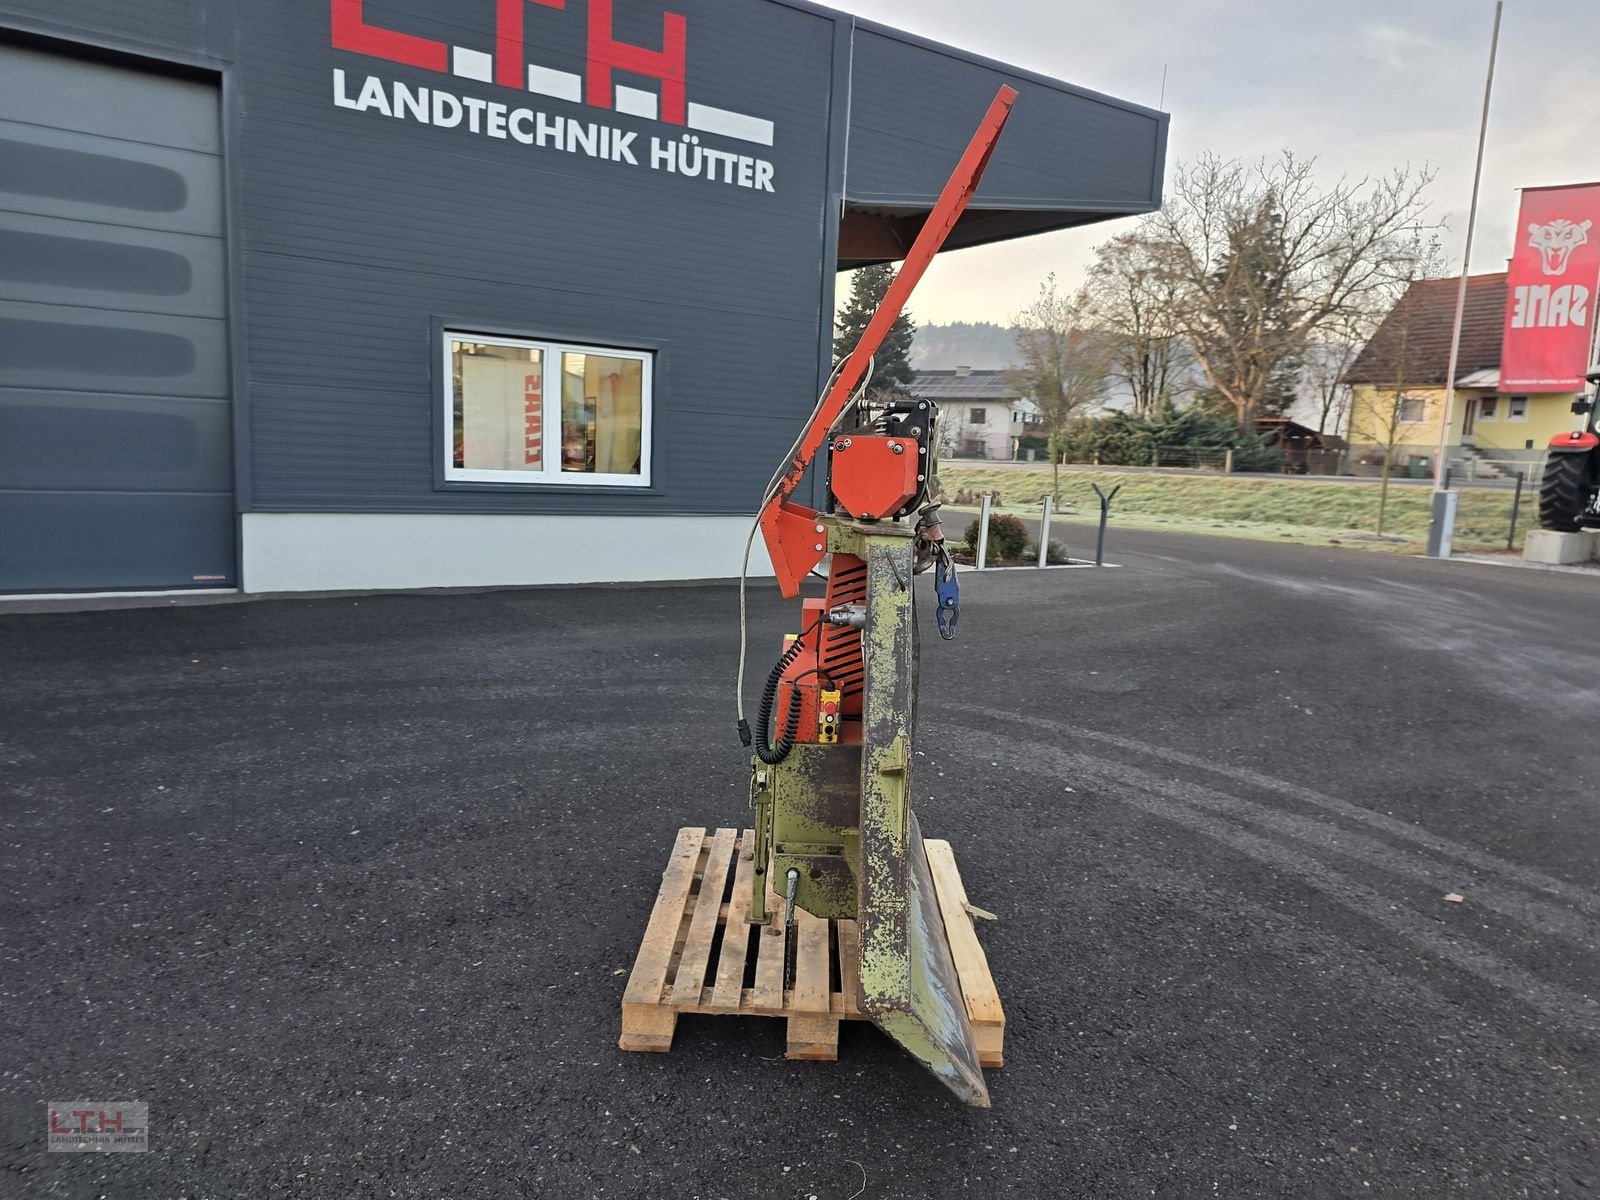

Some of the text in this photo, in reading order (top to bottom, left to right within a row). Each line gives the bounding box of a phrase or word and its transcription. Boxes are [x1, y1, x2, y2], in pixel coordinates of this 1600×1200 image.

[333, 68, 776, 193] LANDTECHNIK HÜTTER
[525, 374, 541, 464] CLAAS
